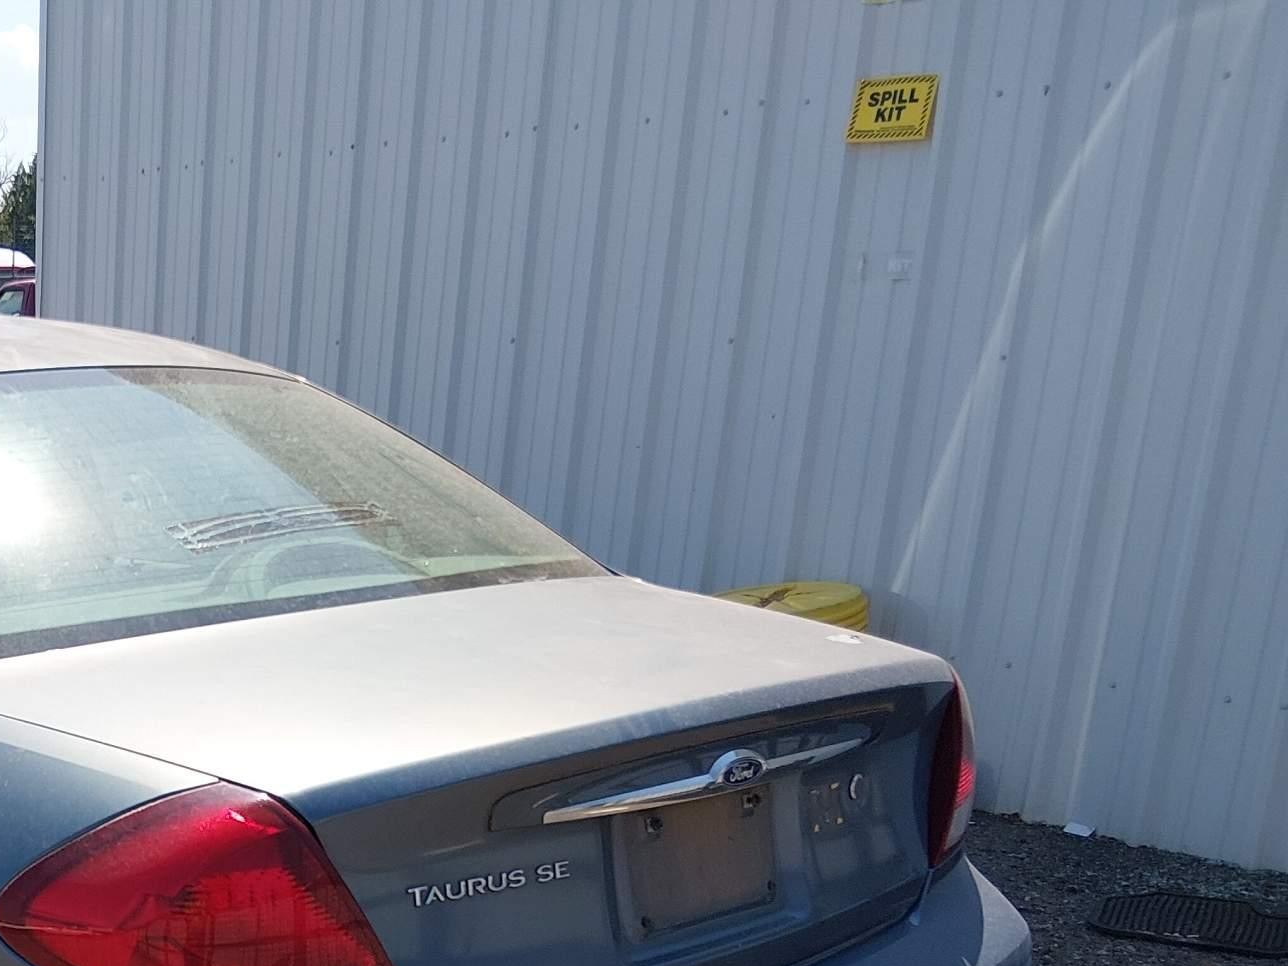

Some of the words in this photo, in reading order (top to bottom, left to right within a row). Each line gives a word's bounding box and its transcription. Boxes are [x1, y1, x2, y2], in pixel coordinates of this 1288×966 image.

[868, 88, 919, 107] SPILL
[874, 106, 906, 123] KIT
[727, 765, 756, 783] Ford
[408, 868, 527, 907] TAURUS
[537, 860, 571, 881] SE
